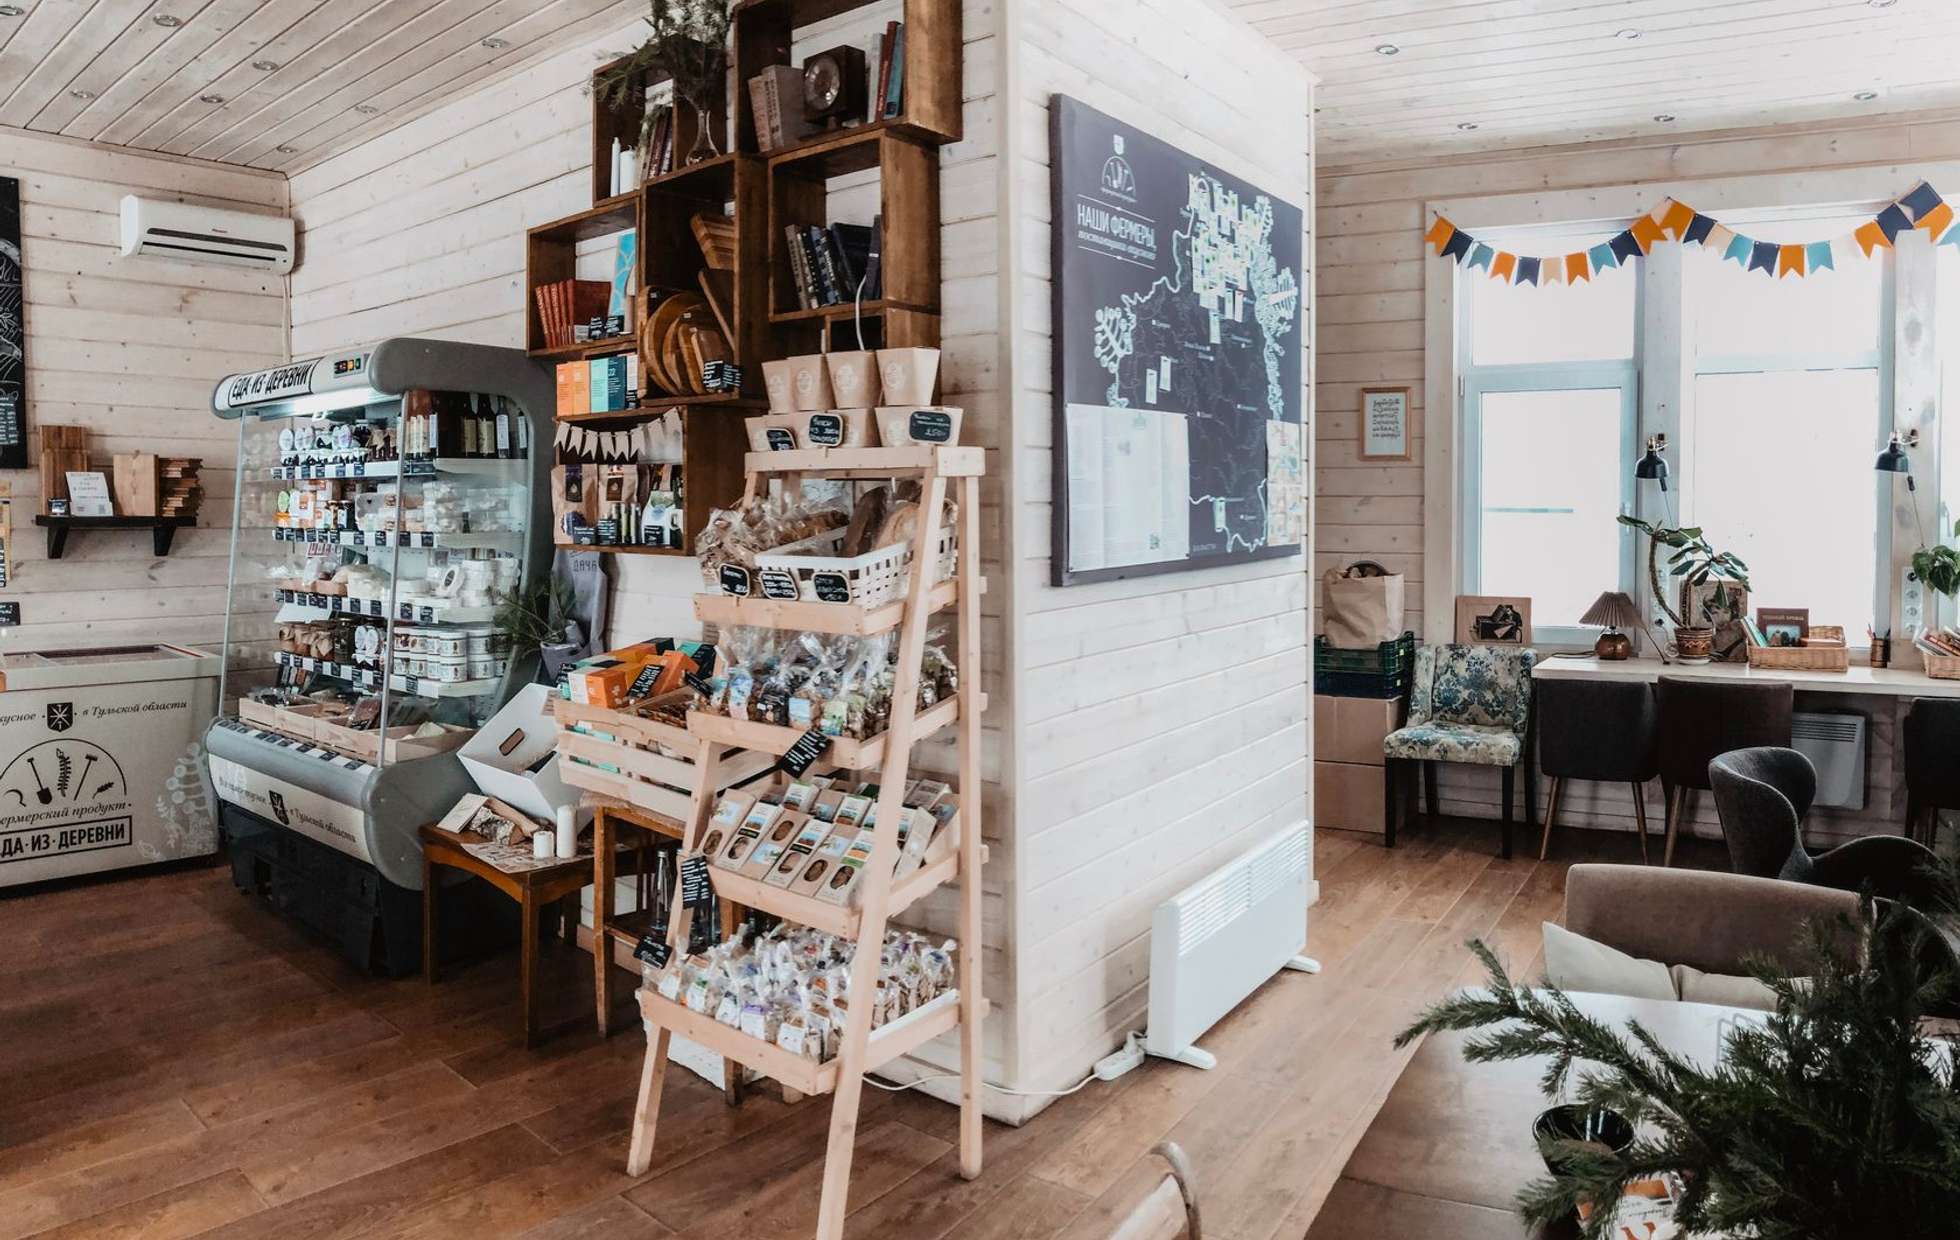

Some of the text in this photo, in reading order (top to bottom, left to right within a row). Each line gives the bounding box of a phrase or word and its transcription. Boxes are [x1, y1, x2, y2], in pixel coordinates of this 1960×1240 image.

[1077, 203, 1110, 233] НАШИ
[265, 363, 313, 394] ДЕРЕВНИ
[92, 703, 140, 719] Тульской
[142, 701, 188, 712] области
[72, 802, 126, 819] продукт
[58, 823, 125, 850] ДЕРЕВНИ
